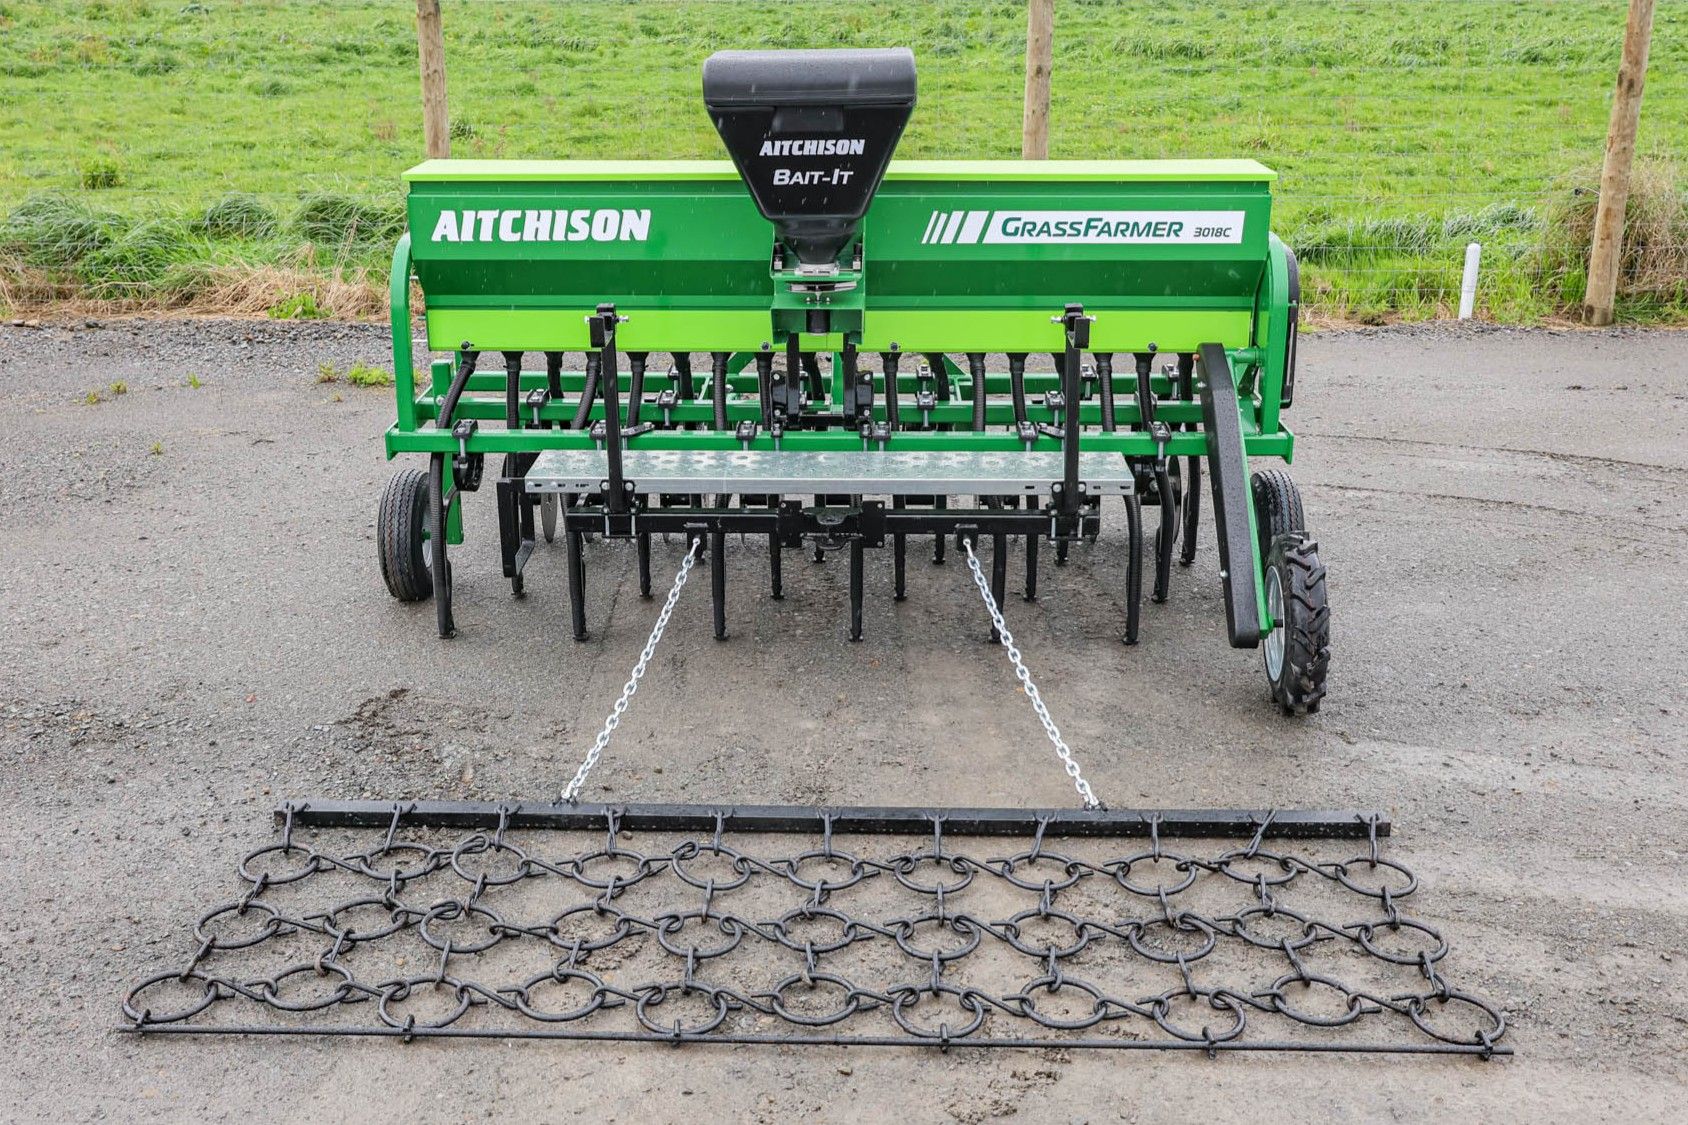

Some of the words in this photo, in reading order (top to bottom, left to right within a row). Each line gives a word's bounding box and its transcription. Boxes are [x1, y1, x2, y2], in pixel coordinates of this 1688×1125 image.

[759, 139, 866, 156] AITCHISON
[431, 209, 652, 242] AITCHISON
[1193, 227, 1232, 238] 3018C
